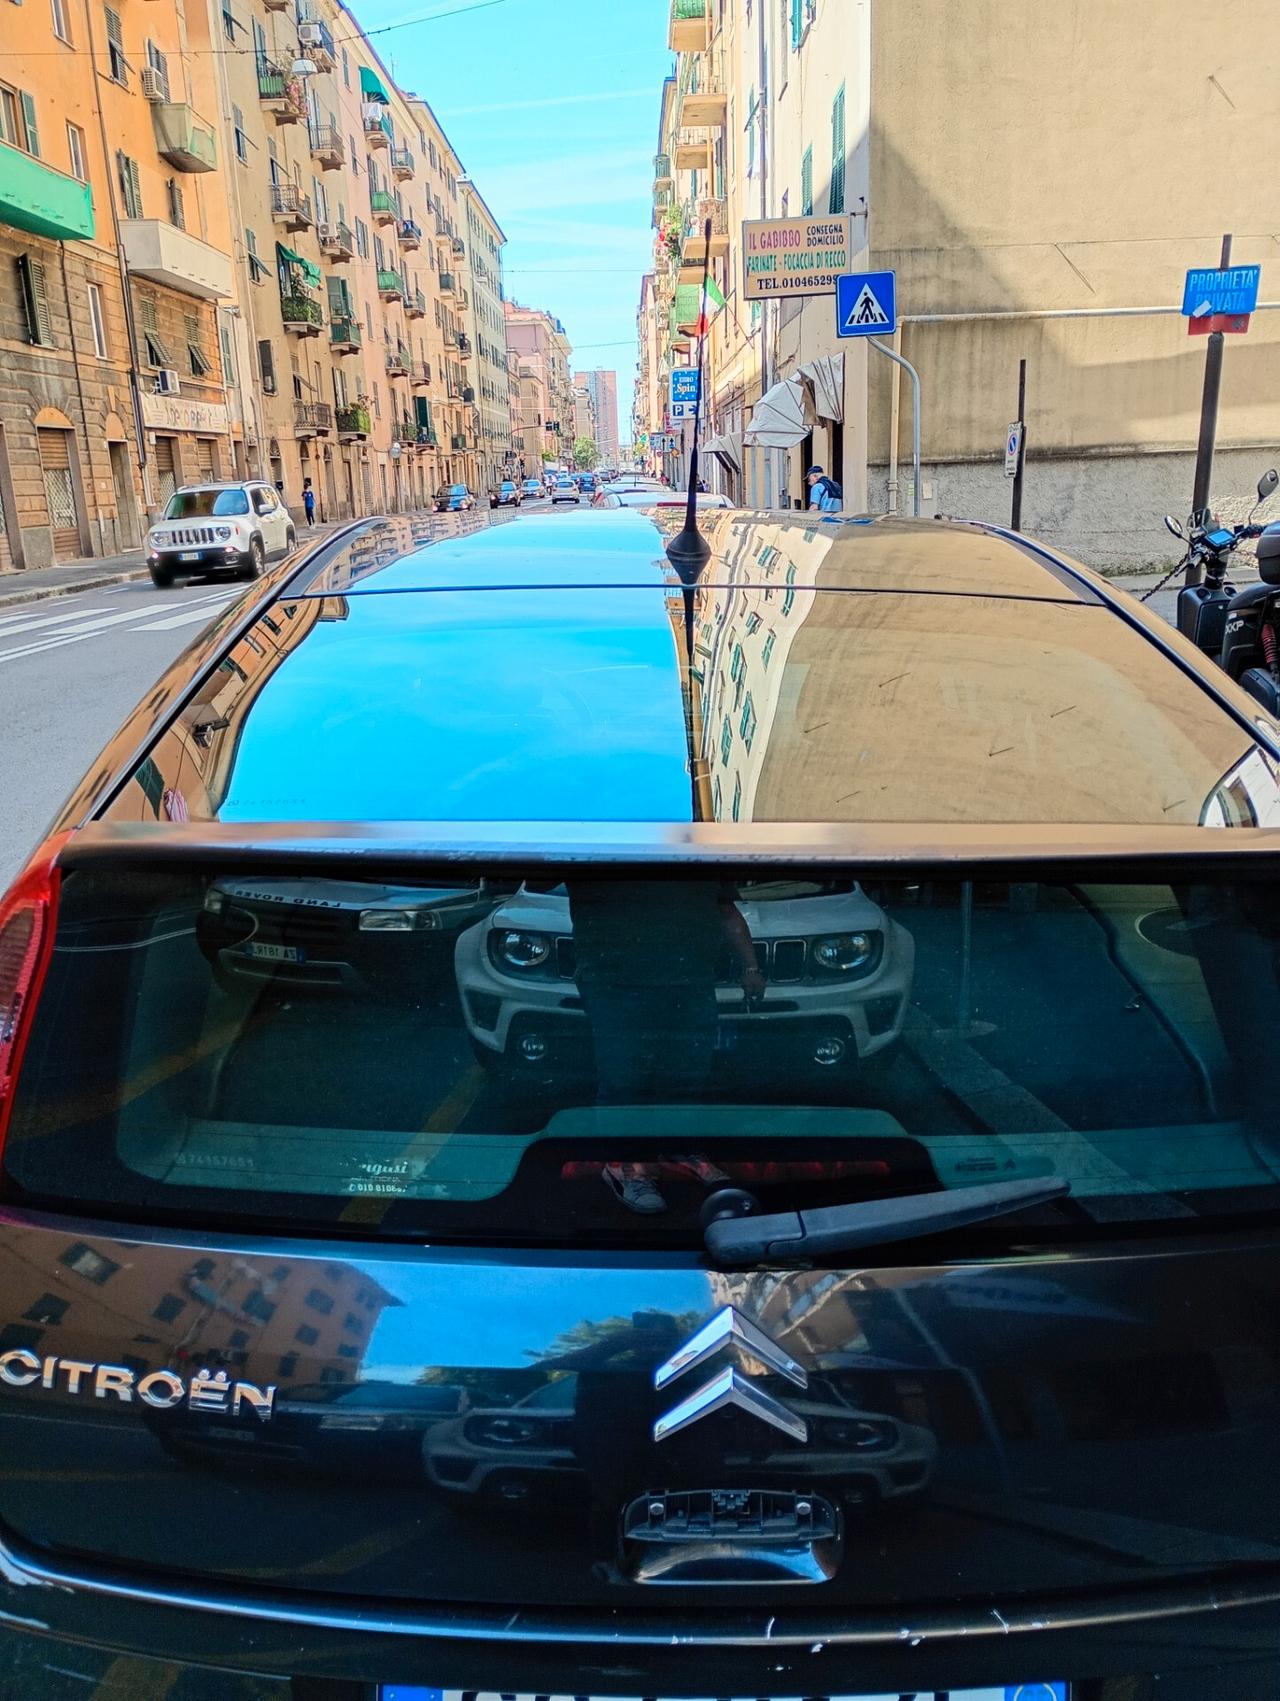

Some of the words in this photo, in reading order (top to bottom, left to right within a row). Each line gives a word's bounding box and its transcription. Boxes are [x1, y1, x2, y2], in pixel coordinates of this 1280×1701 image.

[806, 224, 843, 235] CONSEGNA
[749, 232, 757, 250] IL
[760, 230, 801, 249] GABIBBO
[806, 235, 844, 247] DOMICILIO
[748, 255, 777, 273] FARINATE
[784, 251, 815, 271] FOCACCIA
[825, 250, 846, 268] RECCO
[1189, 270, 1257, 292] PROPRIETA'
[677, 383, 696, 393] Spin
[675, 405, 682, 416] P
[0, 1349, 277, 1422] CITROËN
